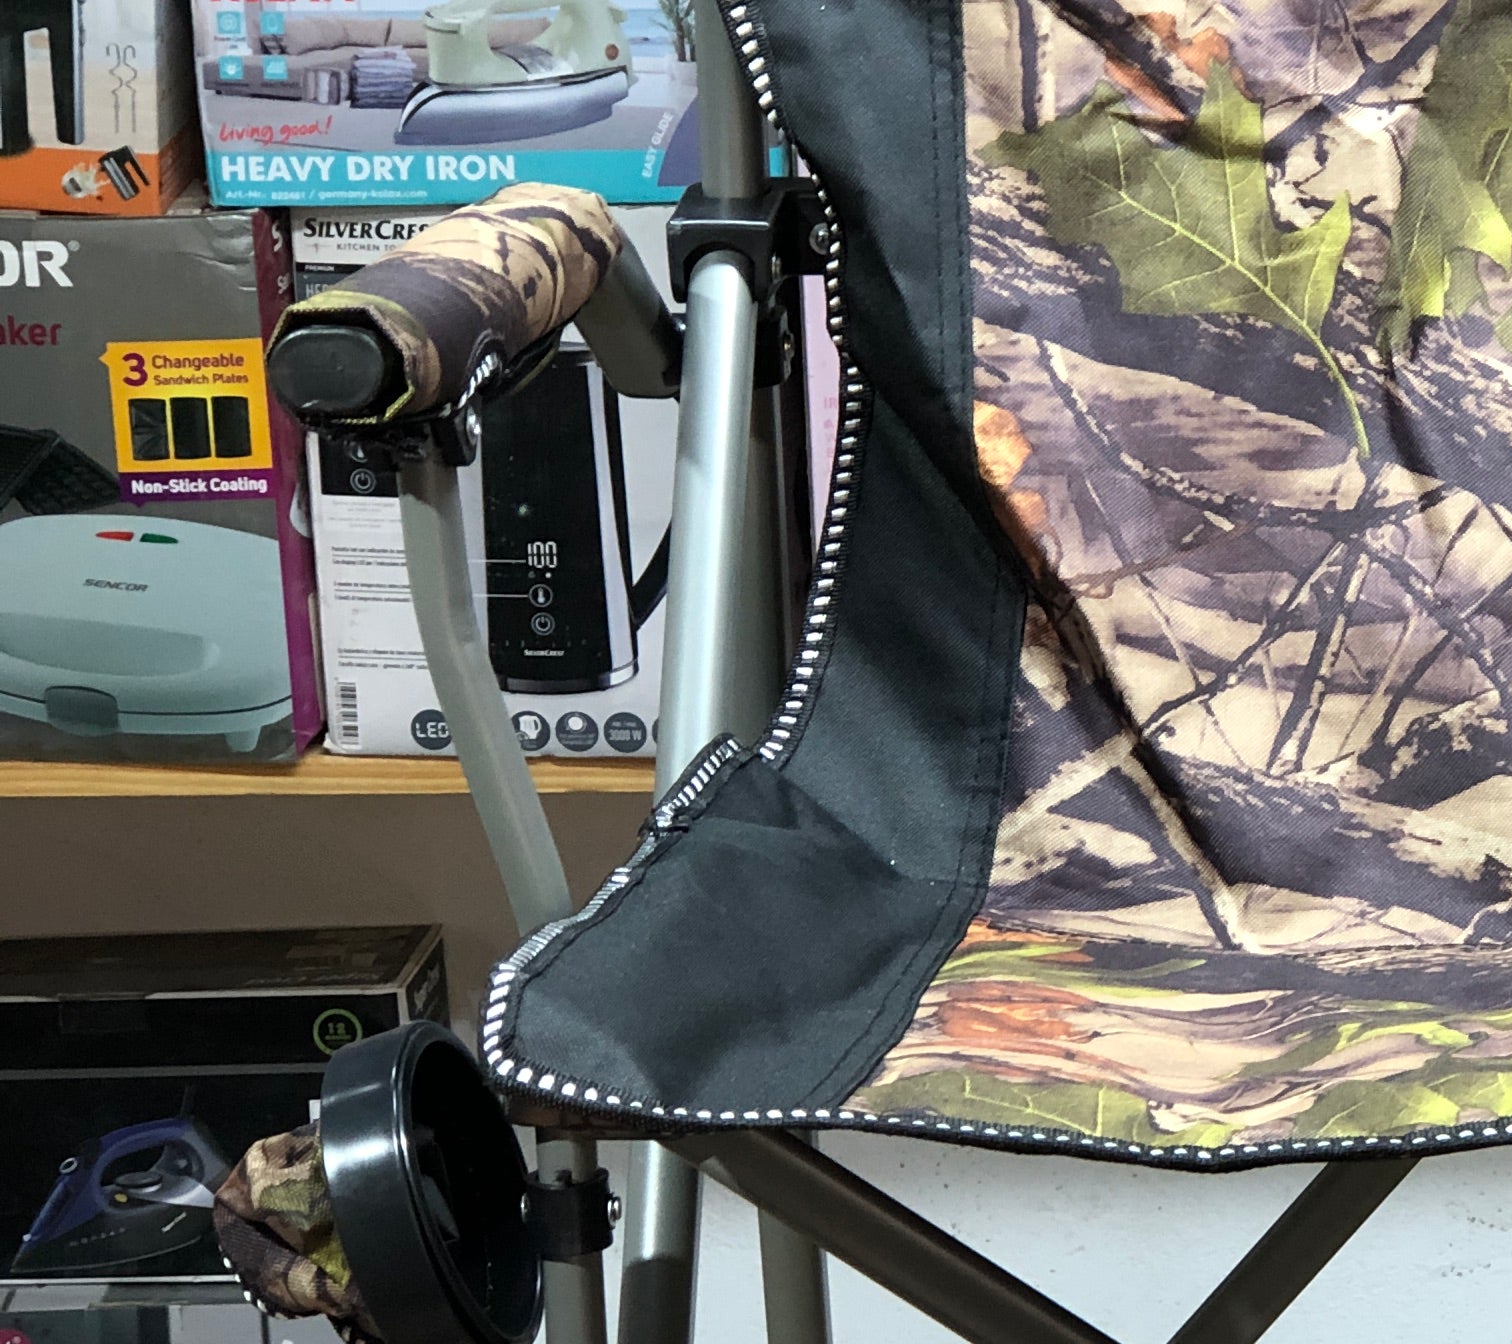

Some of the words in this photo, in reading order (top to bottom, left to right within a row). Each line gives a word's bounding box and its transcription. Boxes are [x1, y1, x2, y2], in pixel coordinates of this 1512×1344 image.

[219, 123, 274, 146] Living
[279, 114, 333, 145] good!
[651, 111, 674, 145] GLIDE
[221, 155, 335, 182] HEAVY
[346, 155, 414, 182] DRY
[426, 155, 516, 181] IRON
[336, 243, 380, 252] KITCHEN
[304, 264, 335, 272] PREMIUM
[122, 352, 148, 387] 3
[152, 353, 245, 371] Changeable
[153, 373, 209, 386] Sandwich
[212, 372, 249, 384] Plates
[131, 478, 207, 494] Non-Stick
[210, 476, 268, 494] Coating
[527, 541, 557, 568] 100
[83, 577, 148, 592] SENCOR
